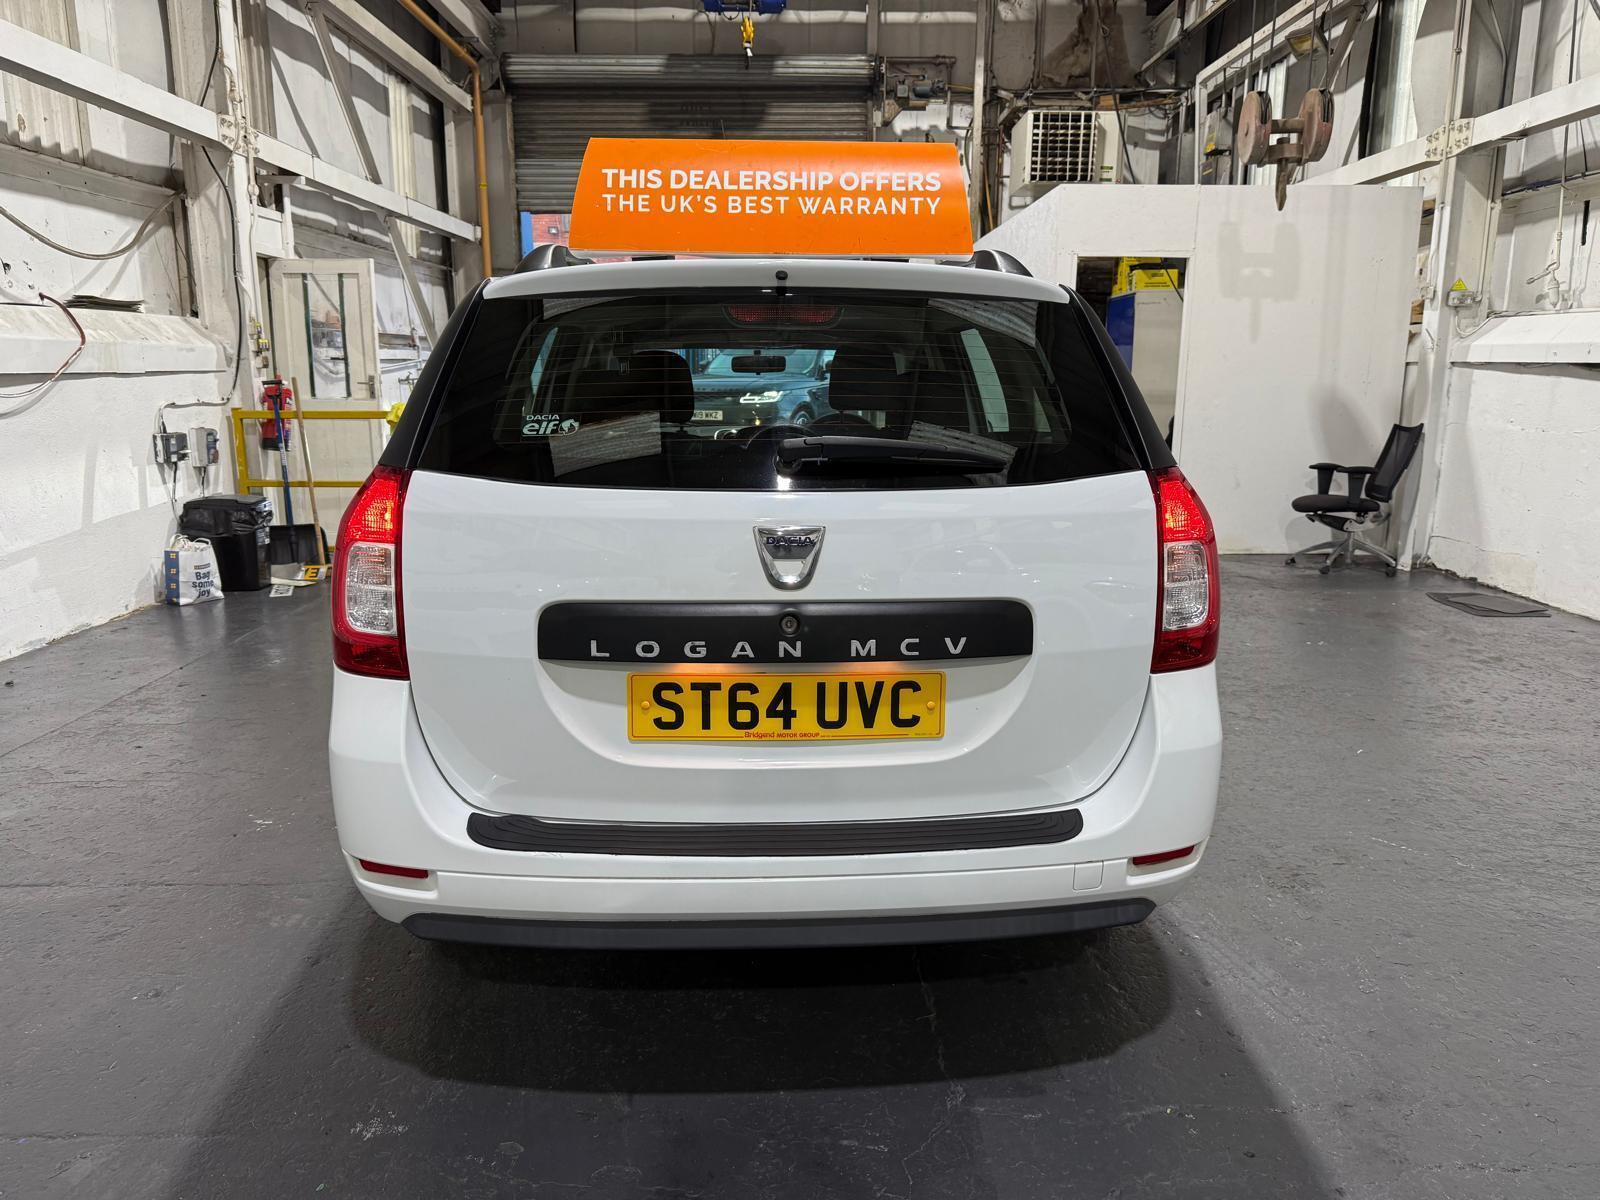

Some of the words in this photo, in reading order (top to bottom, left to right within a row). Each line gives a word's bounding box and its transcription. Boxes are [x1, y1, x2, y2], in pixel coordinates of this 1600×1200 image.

[602, 168, 663, 189] THIS
[670, 169, 834, 191] DEALERSHIP
[839, 171, 941, 192] OFFERS
[602, 194, 651, 212] THE
[661, 195, 717, 213] UK'S
[728, 196, 790, 214] BEST
[798, 197, 941, 215] WARRANTY
[522, 421, 560, 435] elf
[766, 536, 815, 546] DACIA
[195, 571, 211, 581] Bag
[191, 580, 214, 589] some
[197, 588, 211, 598] joy
[590, 639, 802, 659] LOGAN
[850, 636, 968, 657] MCV
[651, 681, 797, 731] ST64
[815, 680, 922, 730] UVC
[744, 731, 775, 739] Bridgend
